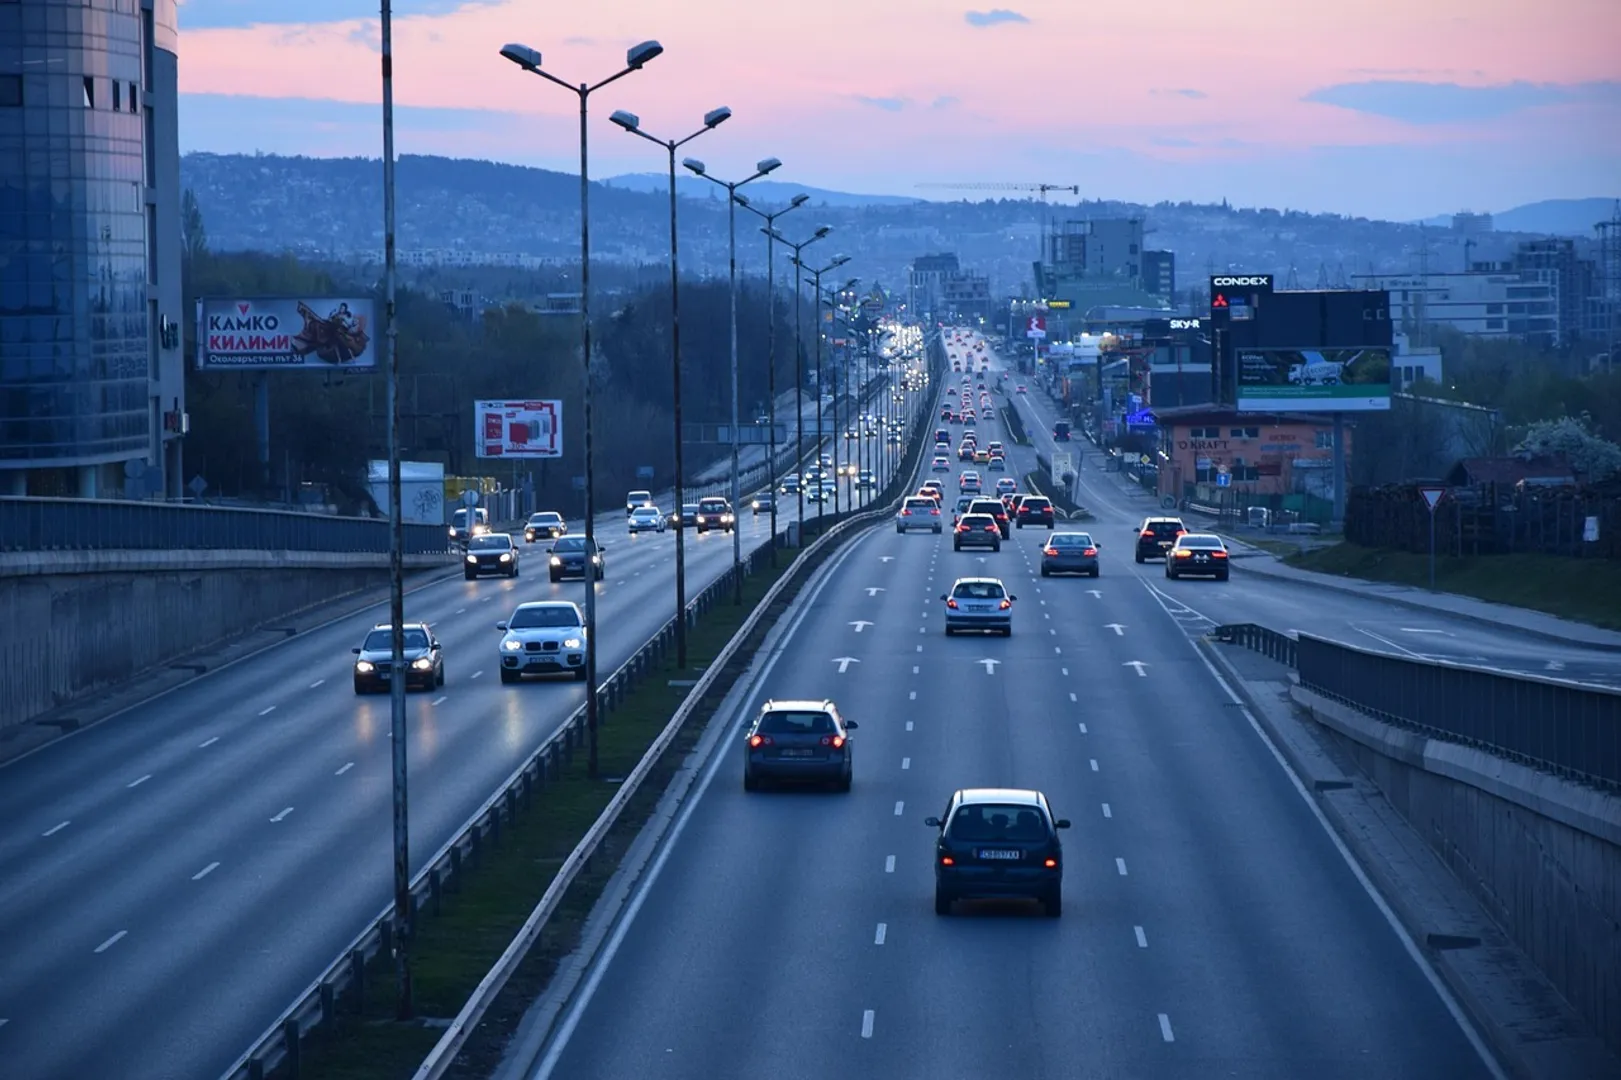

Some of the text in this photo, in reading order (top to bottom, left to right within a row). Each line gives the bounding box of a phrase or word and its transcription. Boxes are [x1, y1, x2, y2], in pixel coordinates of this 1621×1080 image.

[1213, 277, 1268, 286] CONDEX
[209, 315, 279, 331] КАМКО
[209, 335, 289, 350] КИЛИМИ
[1190, 440, 1229, 450] KRAFT
